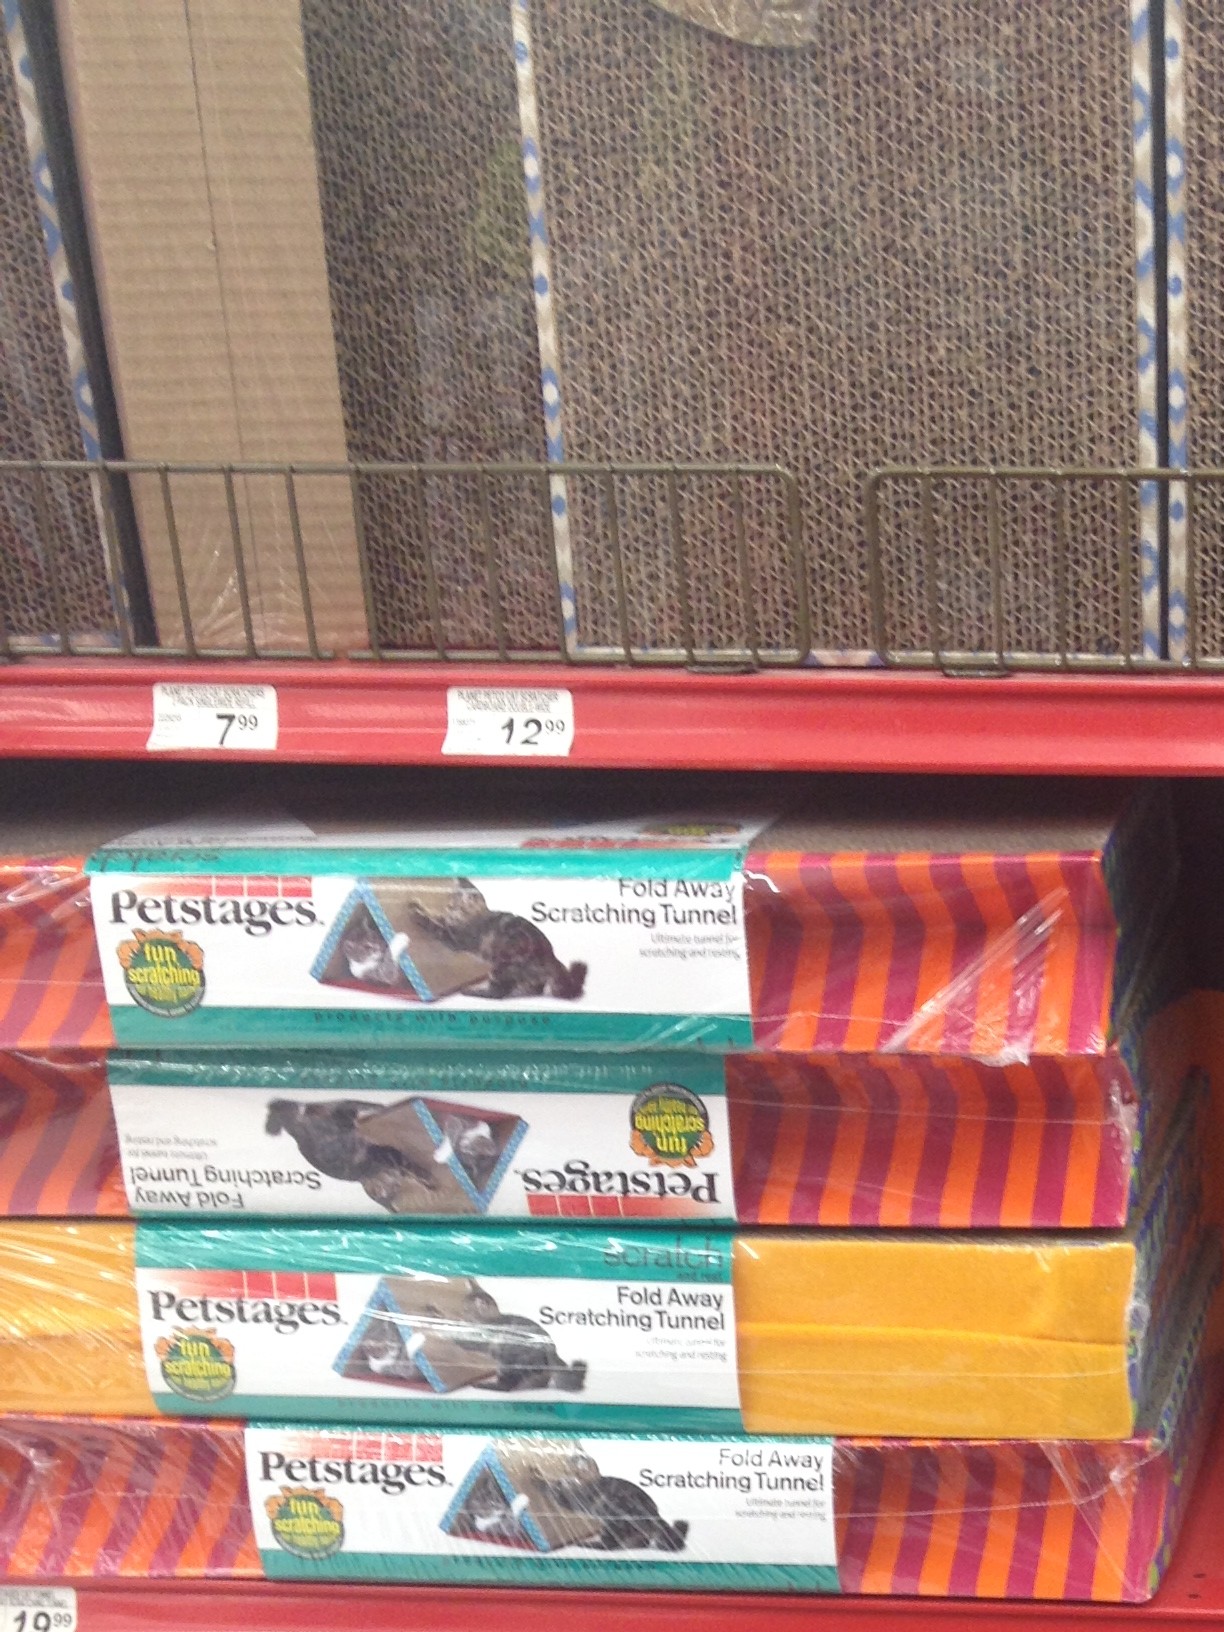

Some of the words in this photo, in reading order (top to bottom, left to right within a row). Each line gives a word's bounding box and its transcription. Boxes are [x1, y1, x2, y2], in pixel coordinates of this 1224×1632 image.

[618, 878, 669, 899] Fold
[674, 878, 736, 903] Away
[108, 888, 318, 937] Petstages
[530, 901, 656, 929] Scratching
[661, 904, 738, 927] Tunnel
[130, 1166, 200, 1188] Tunnel
[204, 1165, 323, 1190] Scratching
[521, 1159, 722, 1204] Petstages
[134, 1187, 190, 1208] Away
[194, 1189, 246, 1210] Fold
[616, 1285, 663, 1306] Fold
[667, 1287, 724, 1312] Away
[147, 1288, 342, 1336] Petstages
[539, 1305, 652, 1333] Scratching
[655, 1309, 726, 1332] Tunnel
[259, 1450, 448, 1496] Petstages
[719, 1448, 764, 1468] Fold
[768, 1450, 825, 1472] Away
[638, 1468, 751, 1494] Scratching
[753, 1472, 825, 1492] Tunnel
